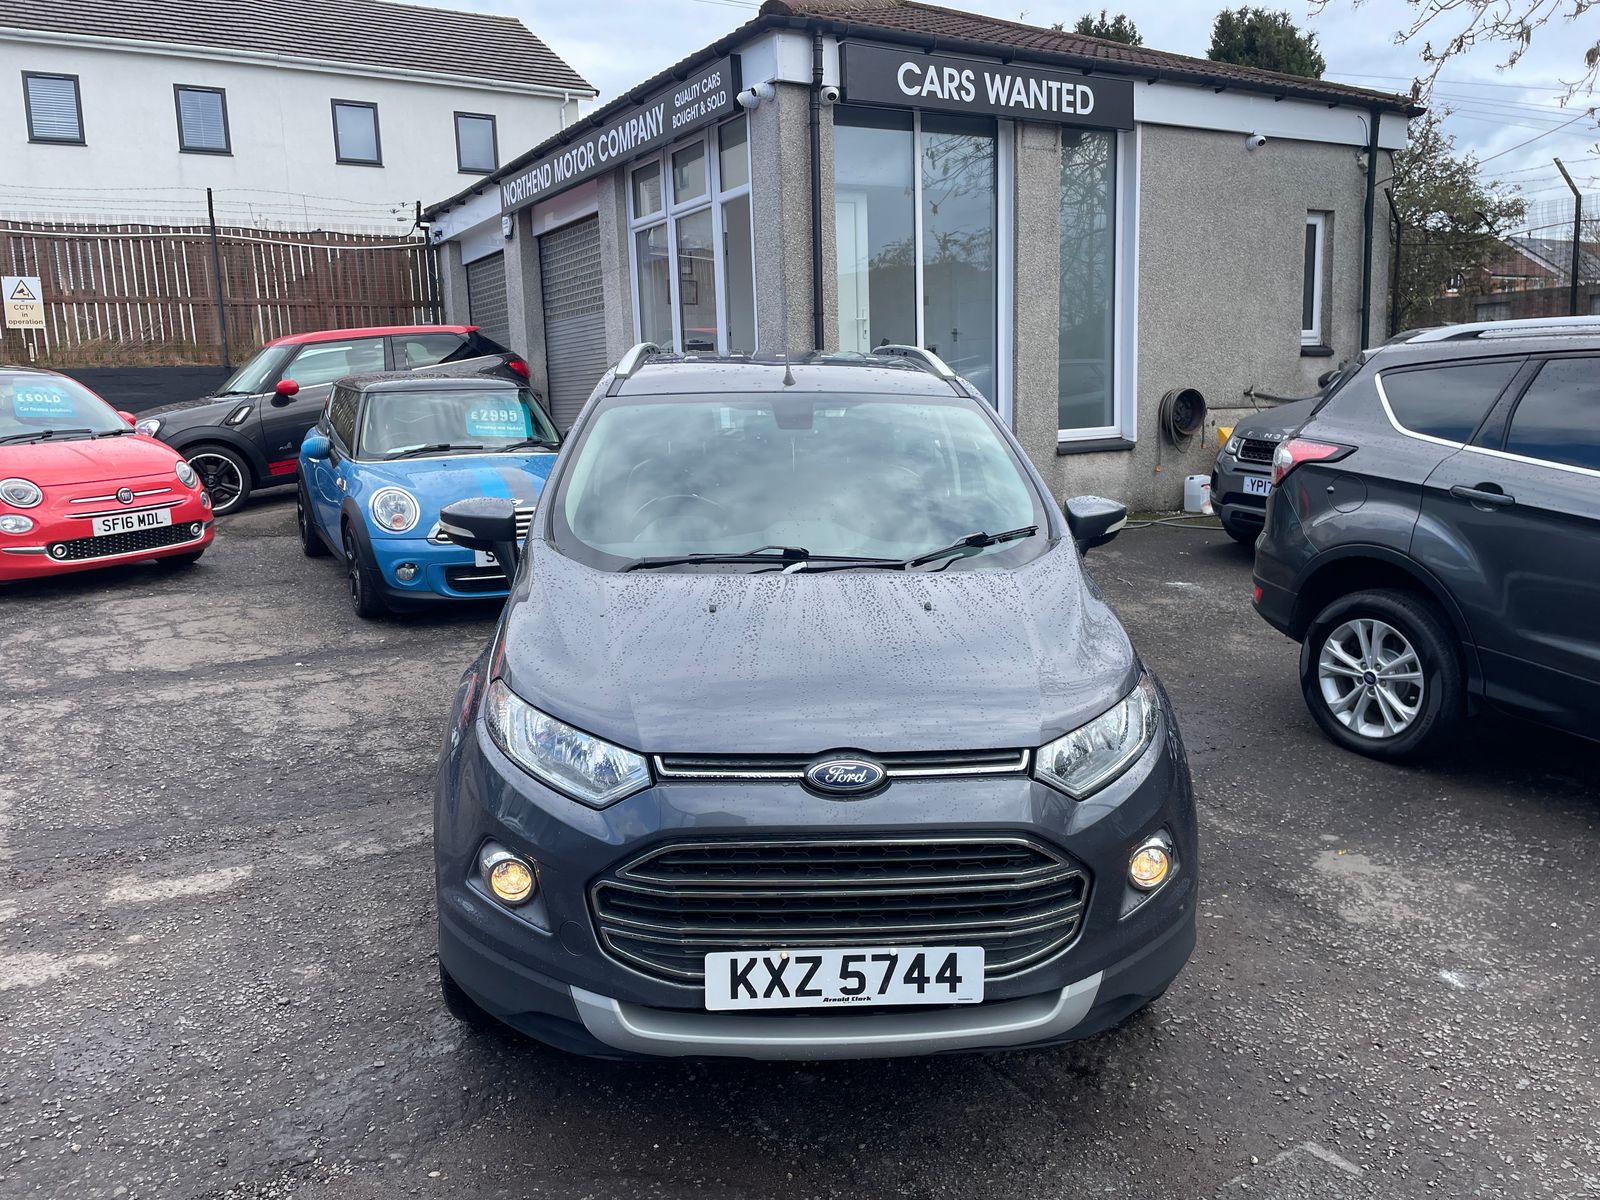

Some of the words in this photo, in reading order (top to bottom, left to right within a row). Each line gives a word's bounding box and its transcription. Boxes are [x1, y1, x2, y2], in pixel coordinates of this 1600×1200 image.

[674, 82, 700, 108] QUALITY
[701, 71, 721, 93] CARS
[897, 62, 976, 103] CARS
[984, 73, 1095, 115] WANTED
[672, 103, 699, 129] BOUGHT
[700, 101, 707, 116] &
[706, 90, 726, 112] SOLD
[503, 163, 551, 207] NORTHEND
[553, 141, 595, 184] MOTOR
[597, 102, 665, 162] COMPANY
[1250, 478, 1272, 495] YP17
[102, 516, 134, 532] SF16
[137, 512, 163, 528] MDL
[825, 765, 867, 783] Ford
[730, 956, 823, 1000] KXZ
[839, 952, 963, 996] 5744
